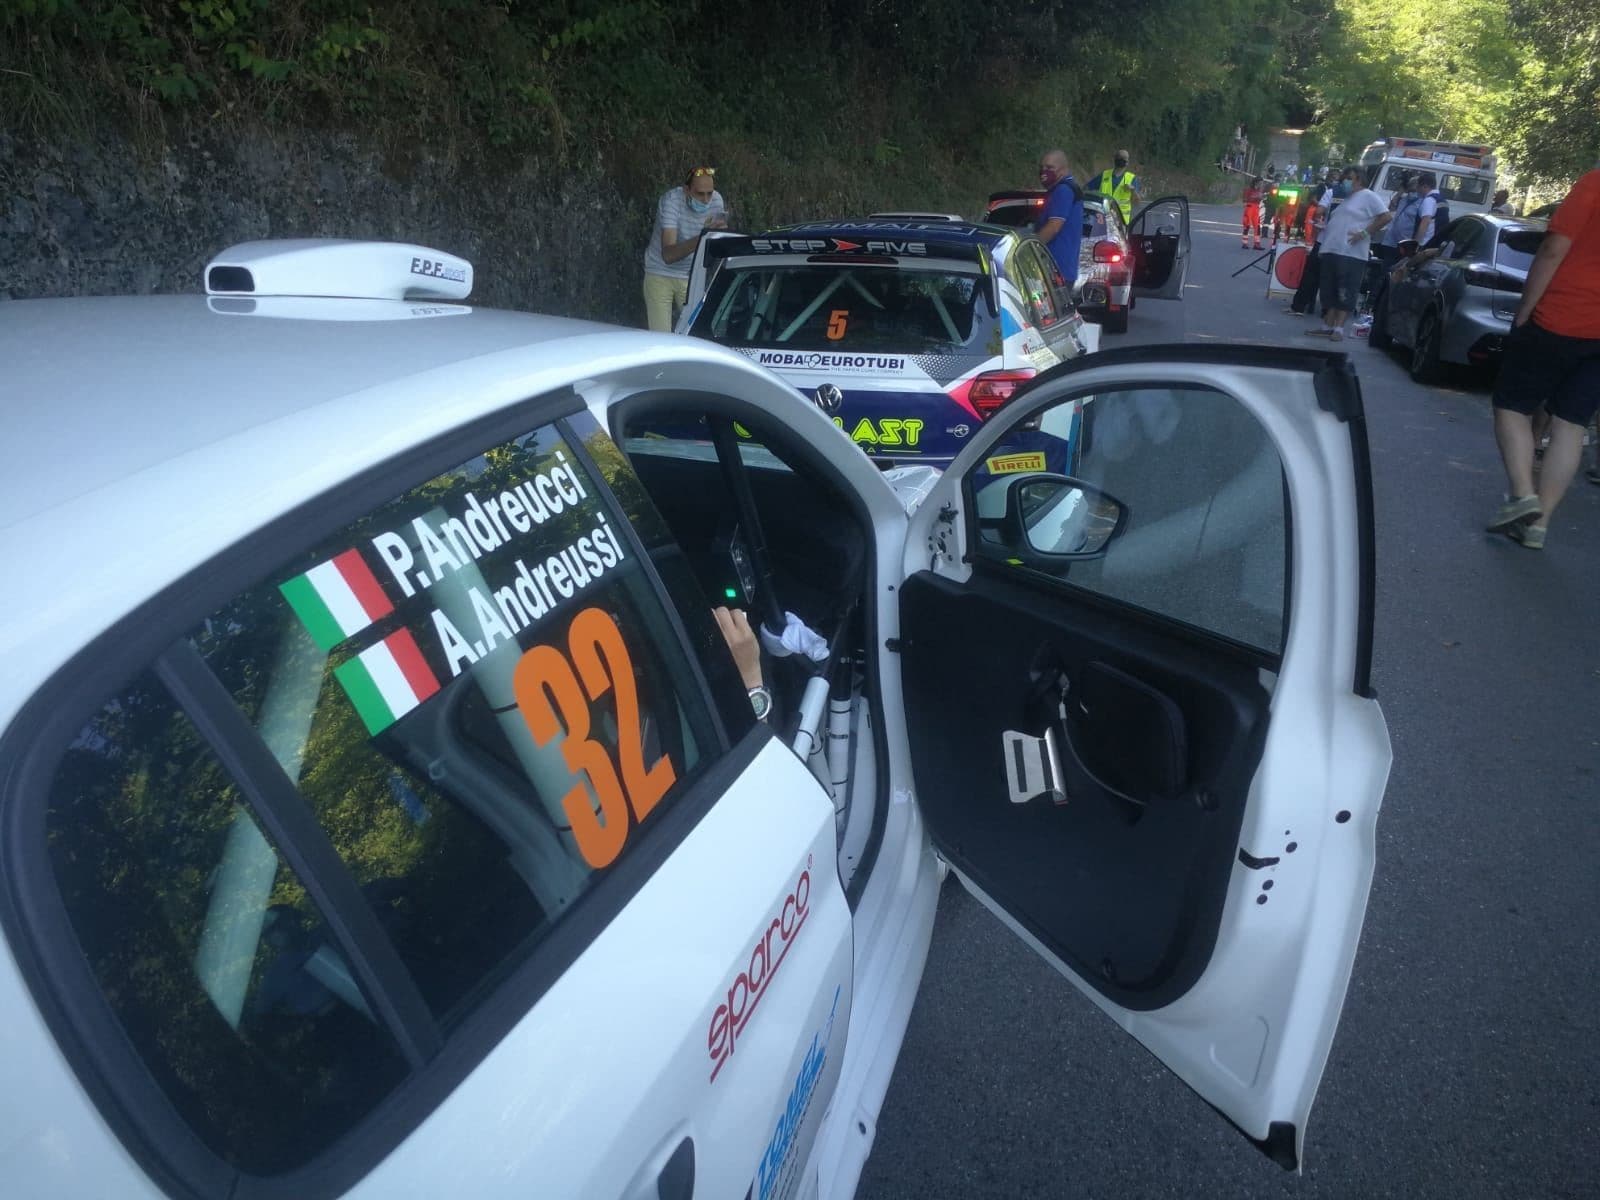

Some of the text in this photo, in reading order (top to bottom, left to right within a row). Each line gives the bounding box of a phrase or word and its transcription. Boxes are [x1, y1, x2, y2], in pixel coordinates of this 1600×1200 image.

[751, 239, 927, 254] STEP FIVE
[759, 353, 905, 369] MOBA EUROTUBI
[826, 309, 849, 341] 5
[992, 455, 1041, 472] PIRELLI
[372, 451, 588, 598] P.Andreucci
[430, 512, 625, 677] A.Andreussi
[512, 607, 677, 869] 32
[708, 870, 810, 1060] sparco
